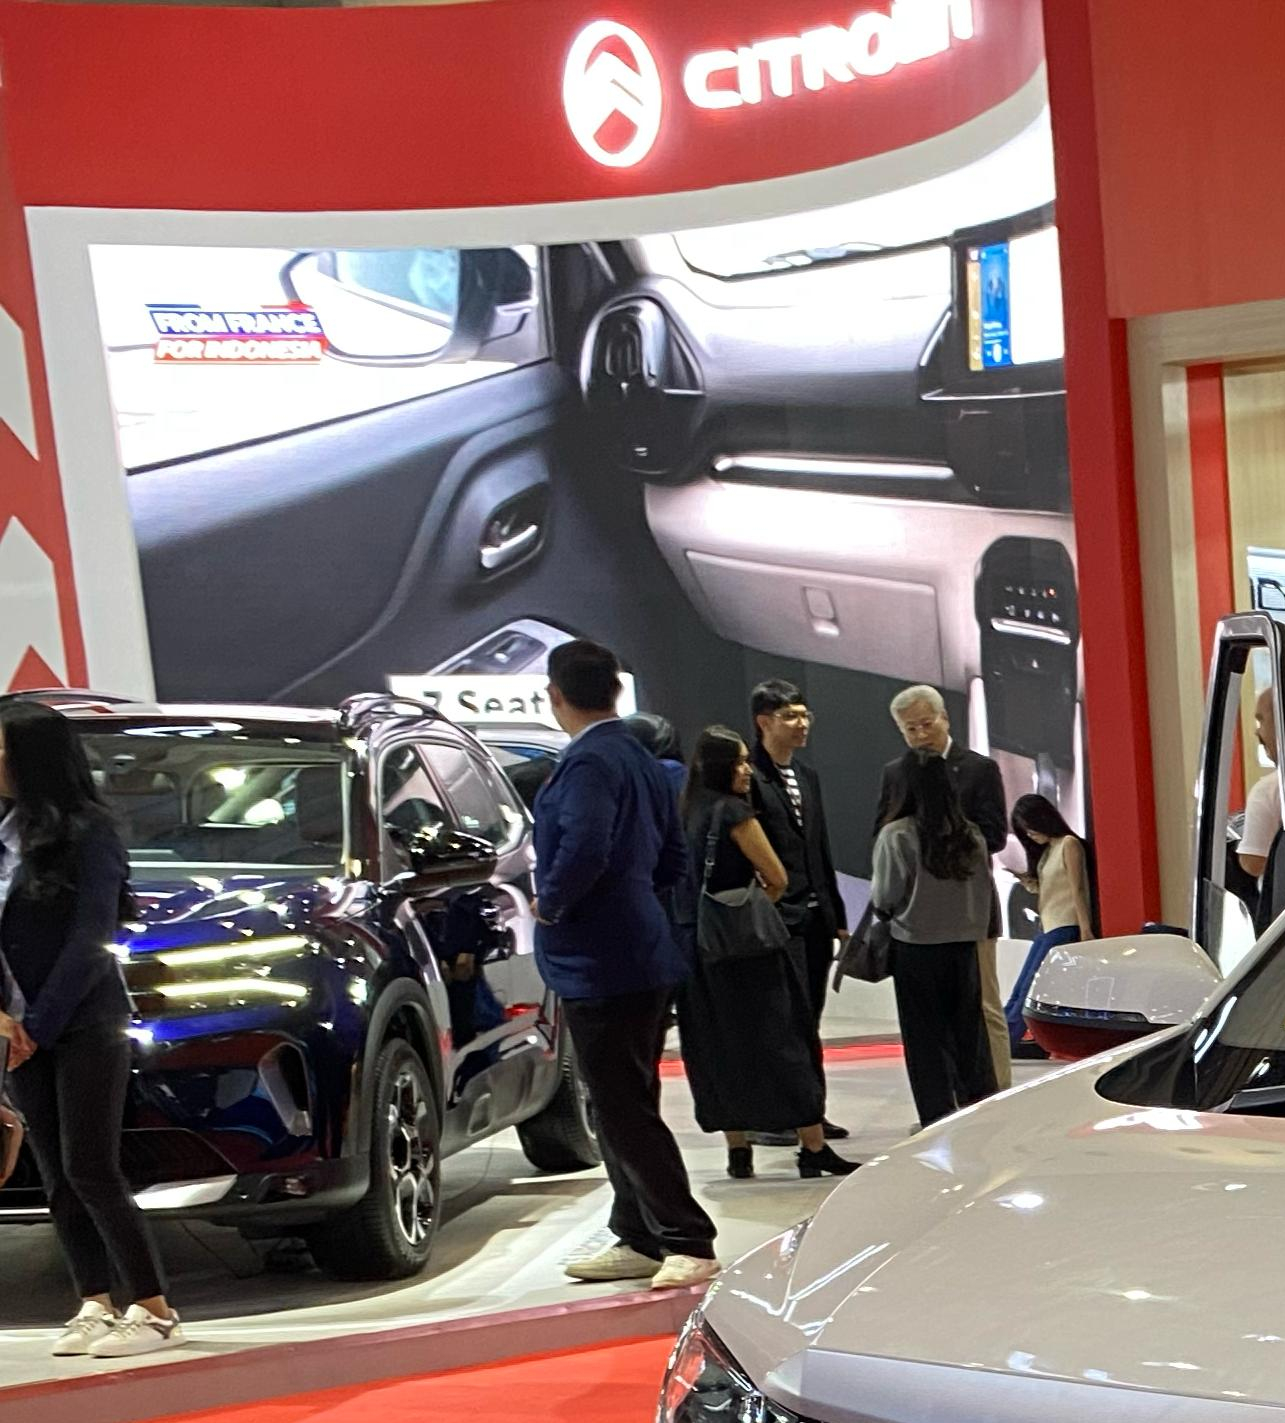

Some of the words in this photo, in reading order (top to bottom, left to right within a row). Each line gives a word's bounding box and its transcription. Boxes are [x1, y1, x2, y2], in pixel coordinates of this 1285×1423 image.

[152, 311, 229, 333] FROM
[224, 311, 322, 333] FRANCE
[156, 339, 204, 360] FOR
[203, 339, 321, 360] INDONESIA
